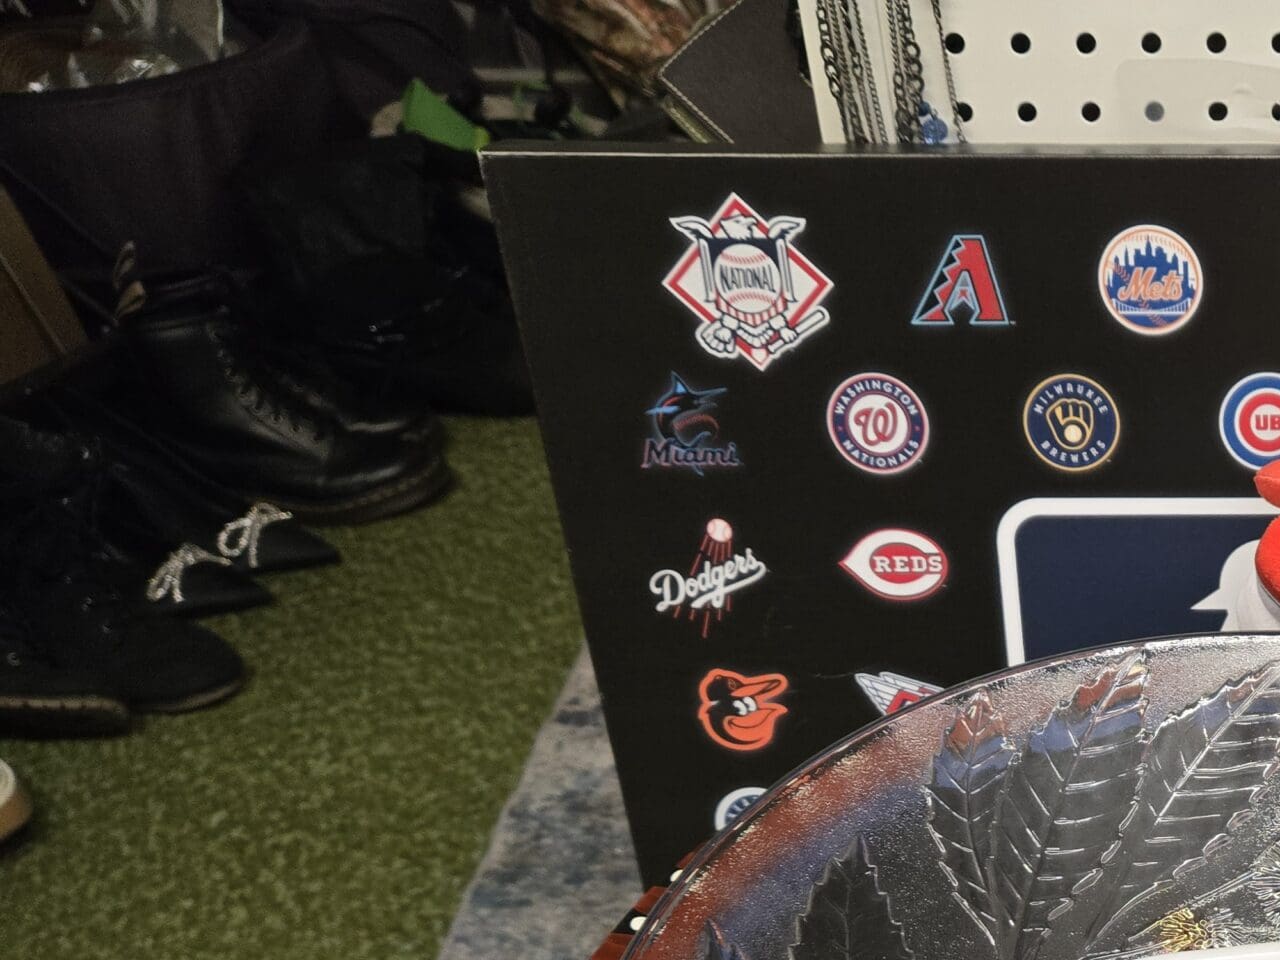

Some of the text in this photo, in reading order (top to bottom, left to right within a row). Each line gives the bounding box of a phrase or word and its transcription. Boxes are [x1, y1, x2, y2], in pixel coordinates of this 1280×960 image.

[719, 264, 776, 293] NATIONAL
[1119, 267, 1184, 301] Mets
[834, 379, 918, 415] WASHINGTON
[1033, 382, 1109, 415] MILWAUKEE
[853, 402, 898, 446] W
[641, 438, 738, 470] Miami
[842, 440, 920, 468] NATIONALS
[1040, 440, 1106, 464] BREWERS
[649, 547, 767, 612] Dodgers
[872, 555, 944, 573] REDS
